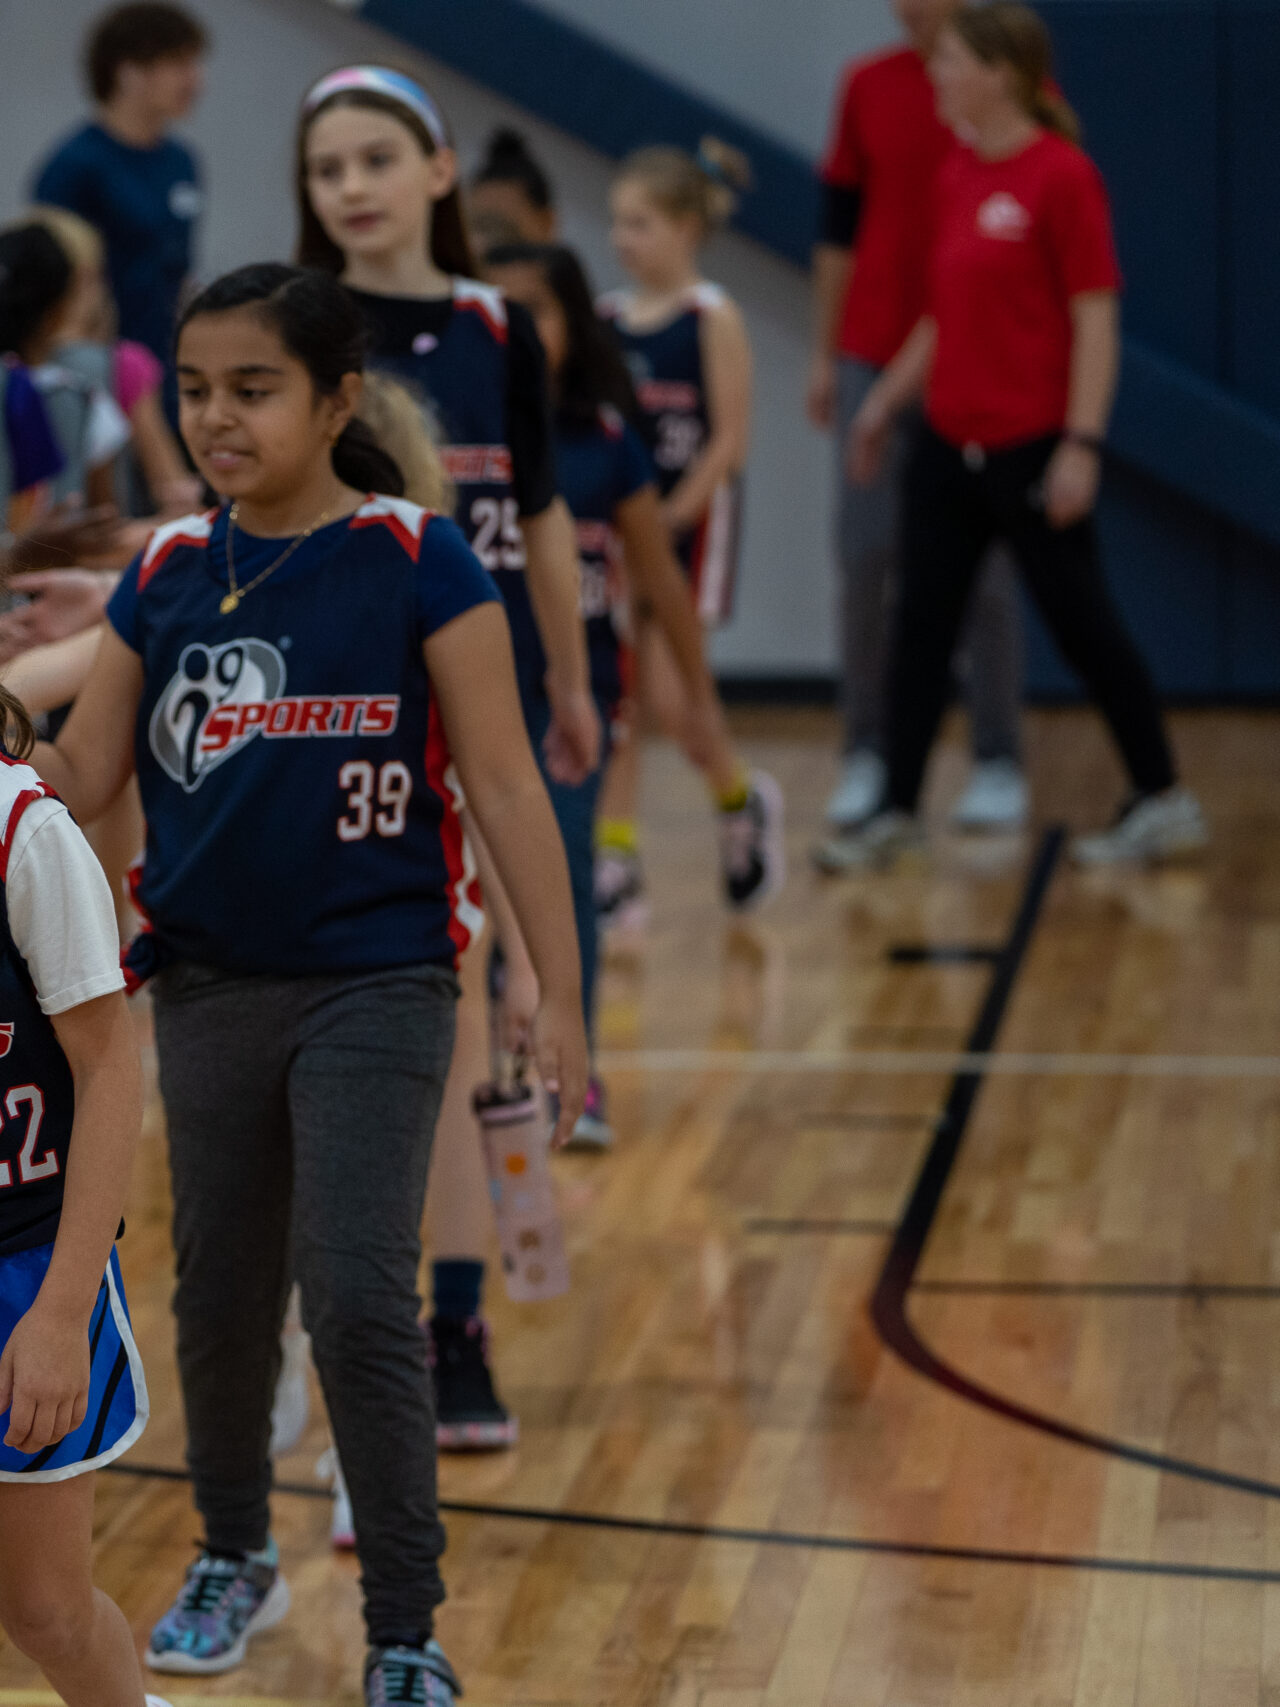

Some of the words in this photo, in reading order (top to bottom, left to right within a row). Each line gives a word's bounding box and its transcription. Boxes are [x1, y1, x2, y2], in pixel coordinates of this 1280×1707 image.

[470, 497, 526, 570] 25
[201, 694, 400, 752] SPORTS
[337, 760, 412, 842] 39
